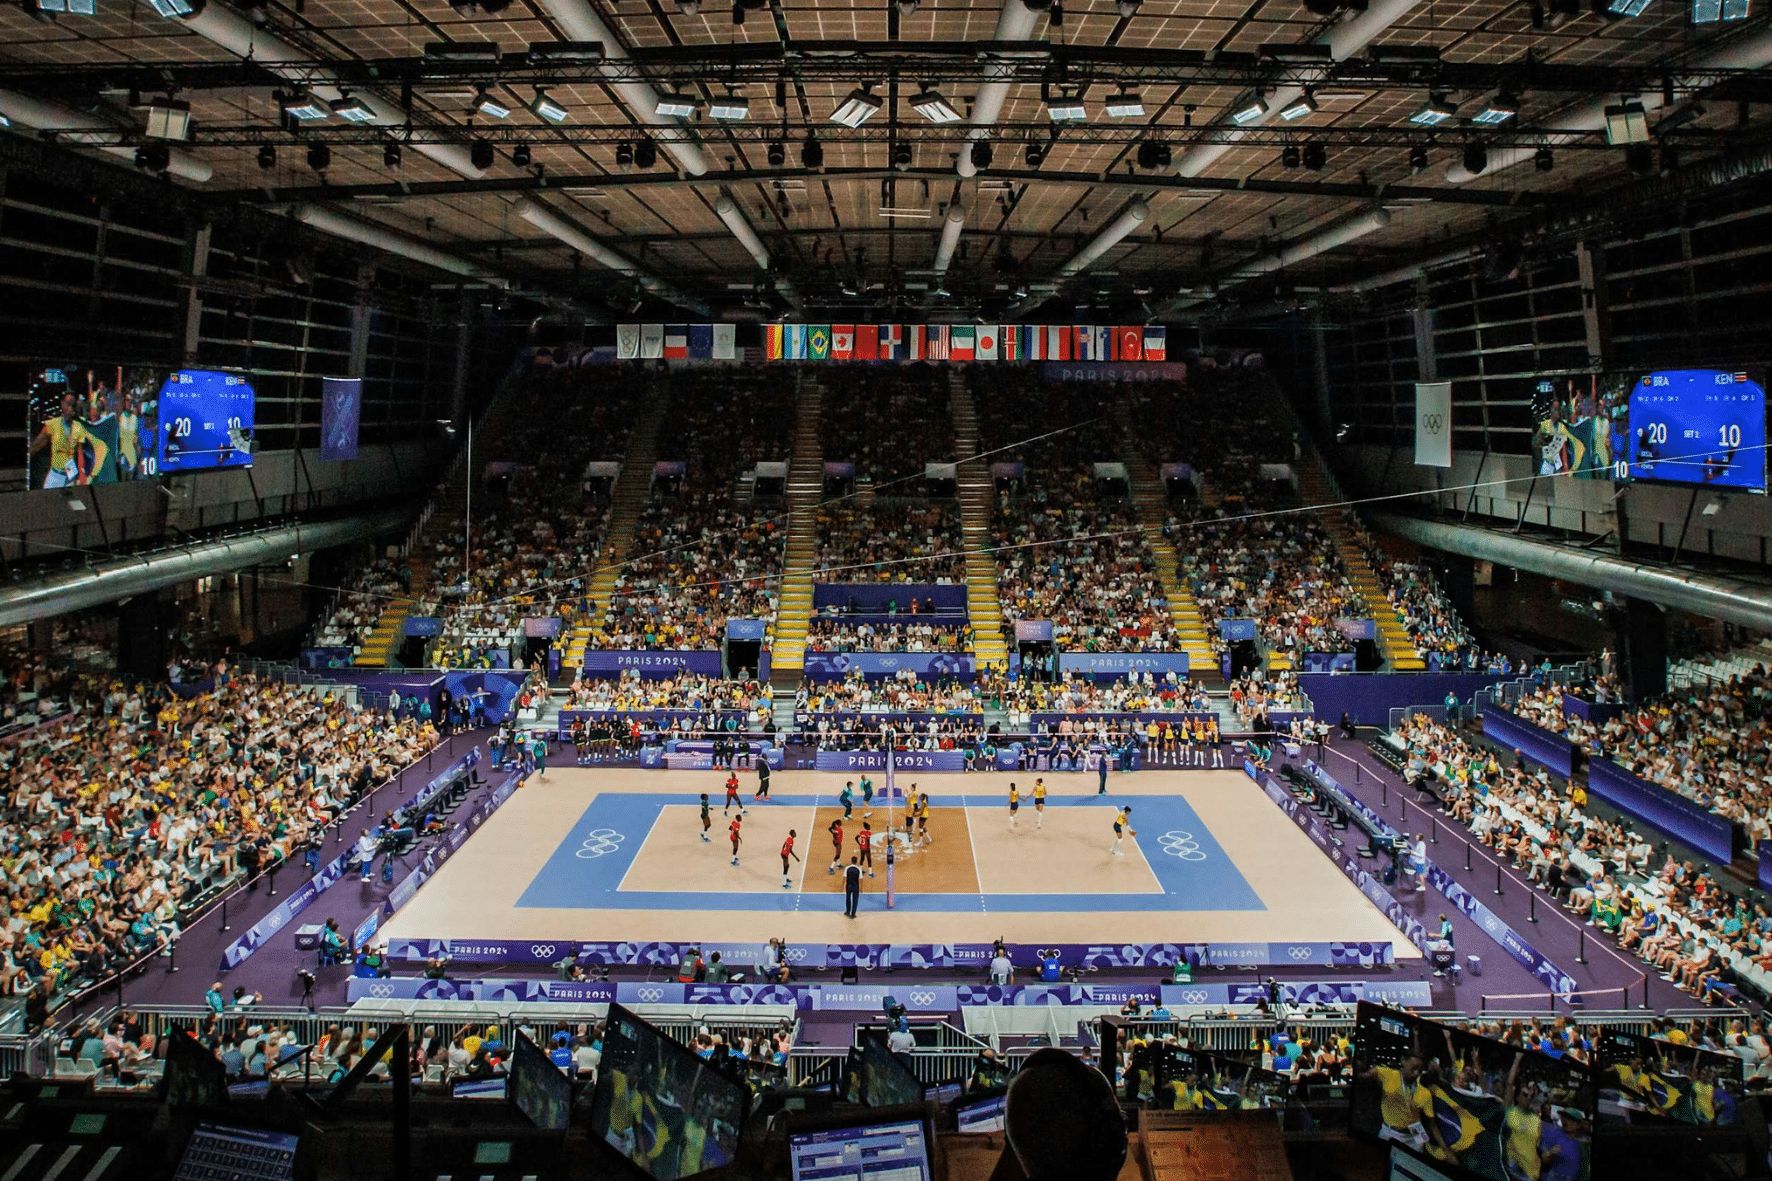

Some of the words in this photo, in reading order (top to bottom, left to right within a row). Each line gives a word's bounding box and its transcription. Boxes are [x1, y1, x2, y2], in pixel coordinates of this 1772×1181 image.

[1653, 376, 1669, 387] BRA
[1715, 373, 1733, 385] KEN
[175, 417, 191, 437] 20
[1648, 423, 1667, 444] 20
[1719, 424, 1741, 447] 10
[141, 457, 156, 475] 10
[1613, 460, 1629, 478] 10
[618, 656, 652, 665] PARIS
[655, 656, 686, 666] 2024
[1091, 658, 1124, 667] PARIS
[1128, 658, 1159, 667] 2024
[895, 756, 932, 766] 2024
[454, 946, 481, 954] PARIS
[483, 947, 508, 955] 2024
[959, 951, 985, 959] PARIS
[1211, 950, 1238, 958] PARIS
[1240, 950, 1265, 958] 2024
[554, 990, 583, 999] PARIS
[585, 990, 612, 999] 2024
[826, 993, 854, 1002] PARIS
[1098, 993, 1127, 1002] PARIS
[1369, 990, 1397, 999] PARIS
[1400, 990, 1425, 999] 2024
